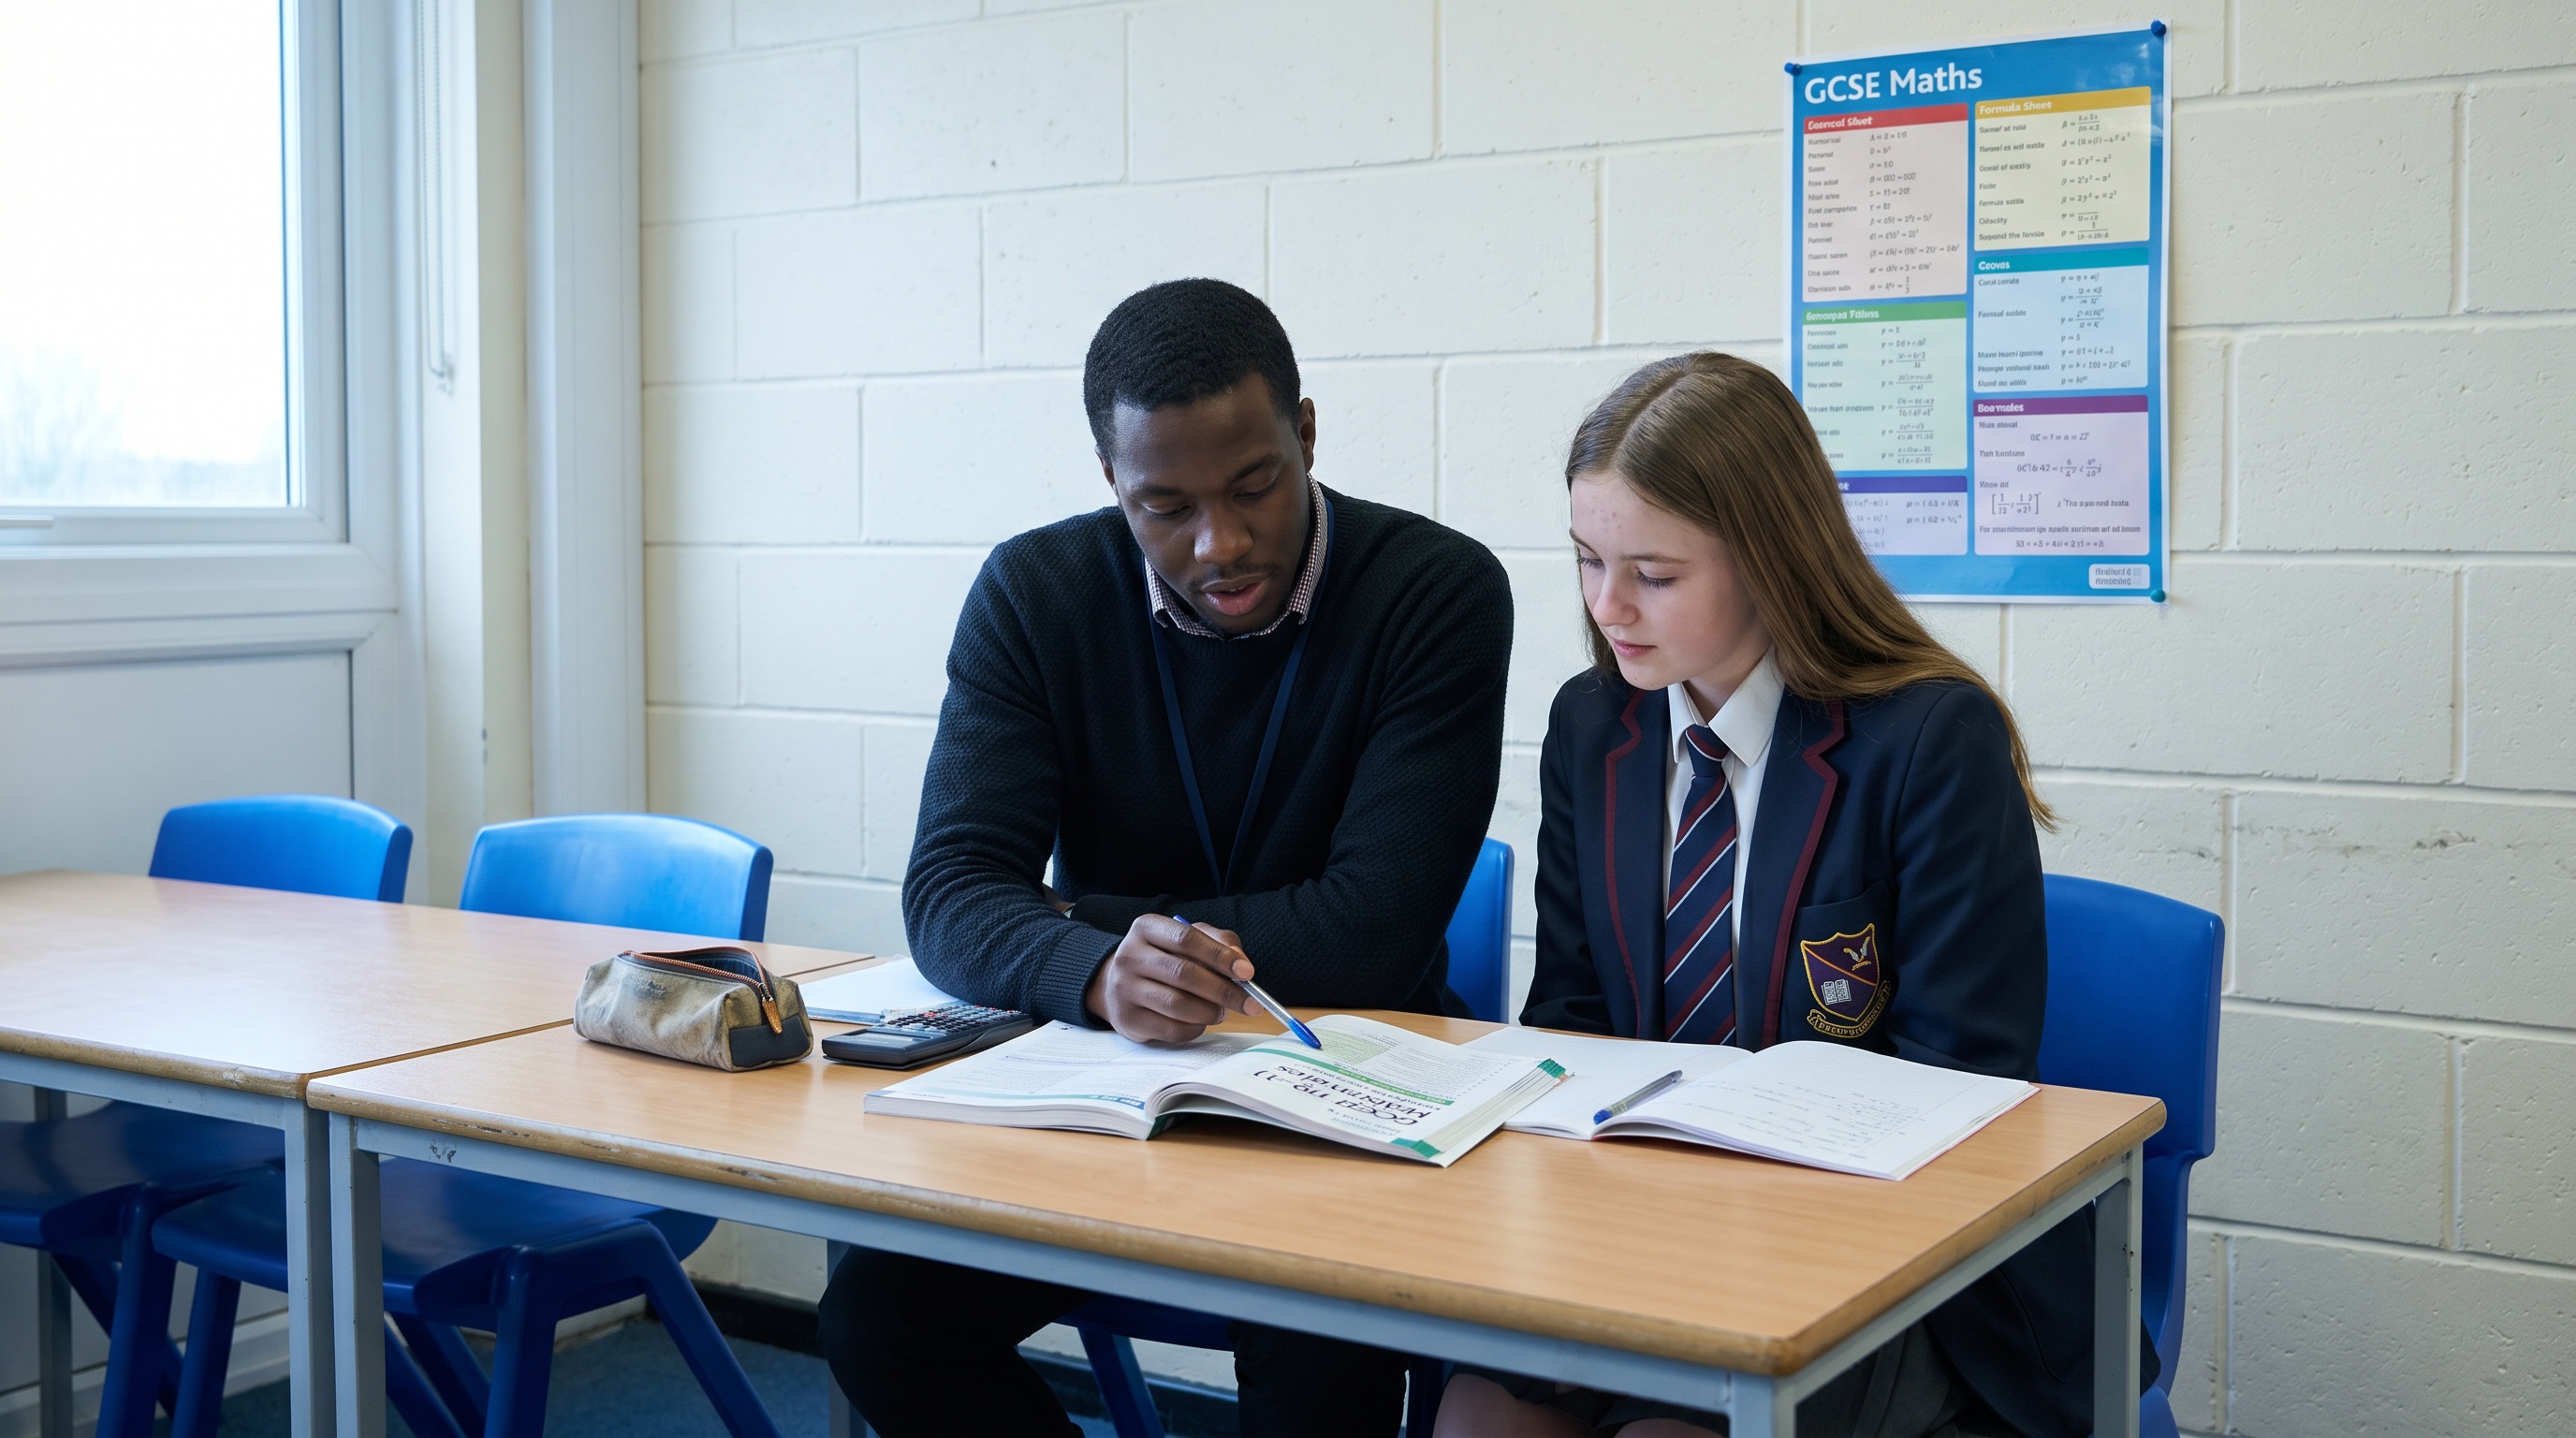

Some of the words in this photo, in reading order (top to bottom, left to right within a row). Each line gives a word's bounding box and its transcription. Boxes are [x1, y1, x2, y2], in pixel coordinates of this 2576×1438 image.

[1804, 73, 1881, 104] GCSE
[1890, 64, 1983, 95] Maths
[1980, 103, 2021, 114] Formula
[2023, 101, 2052, 110] Sheet
